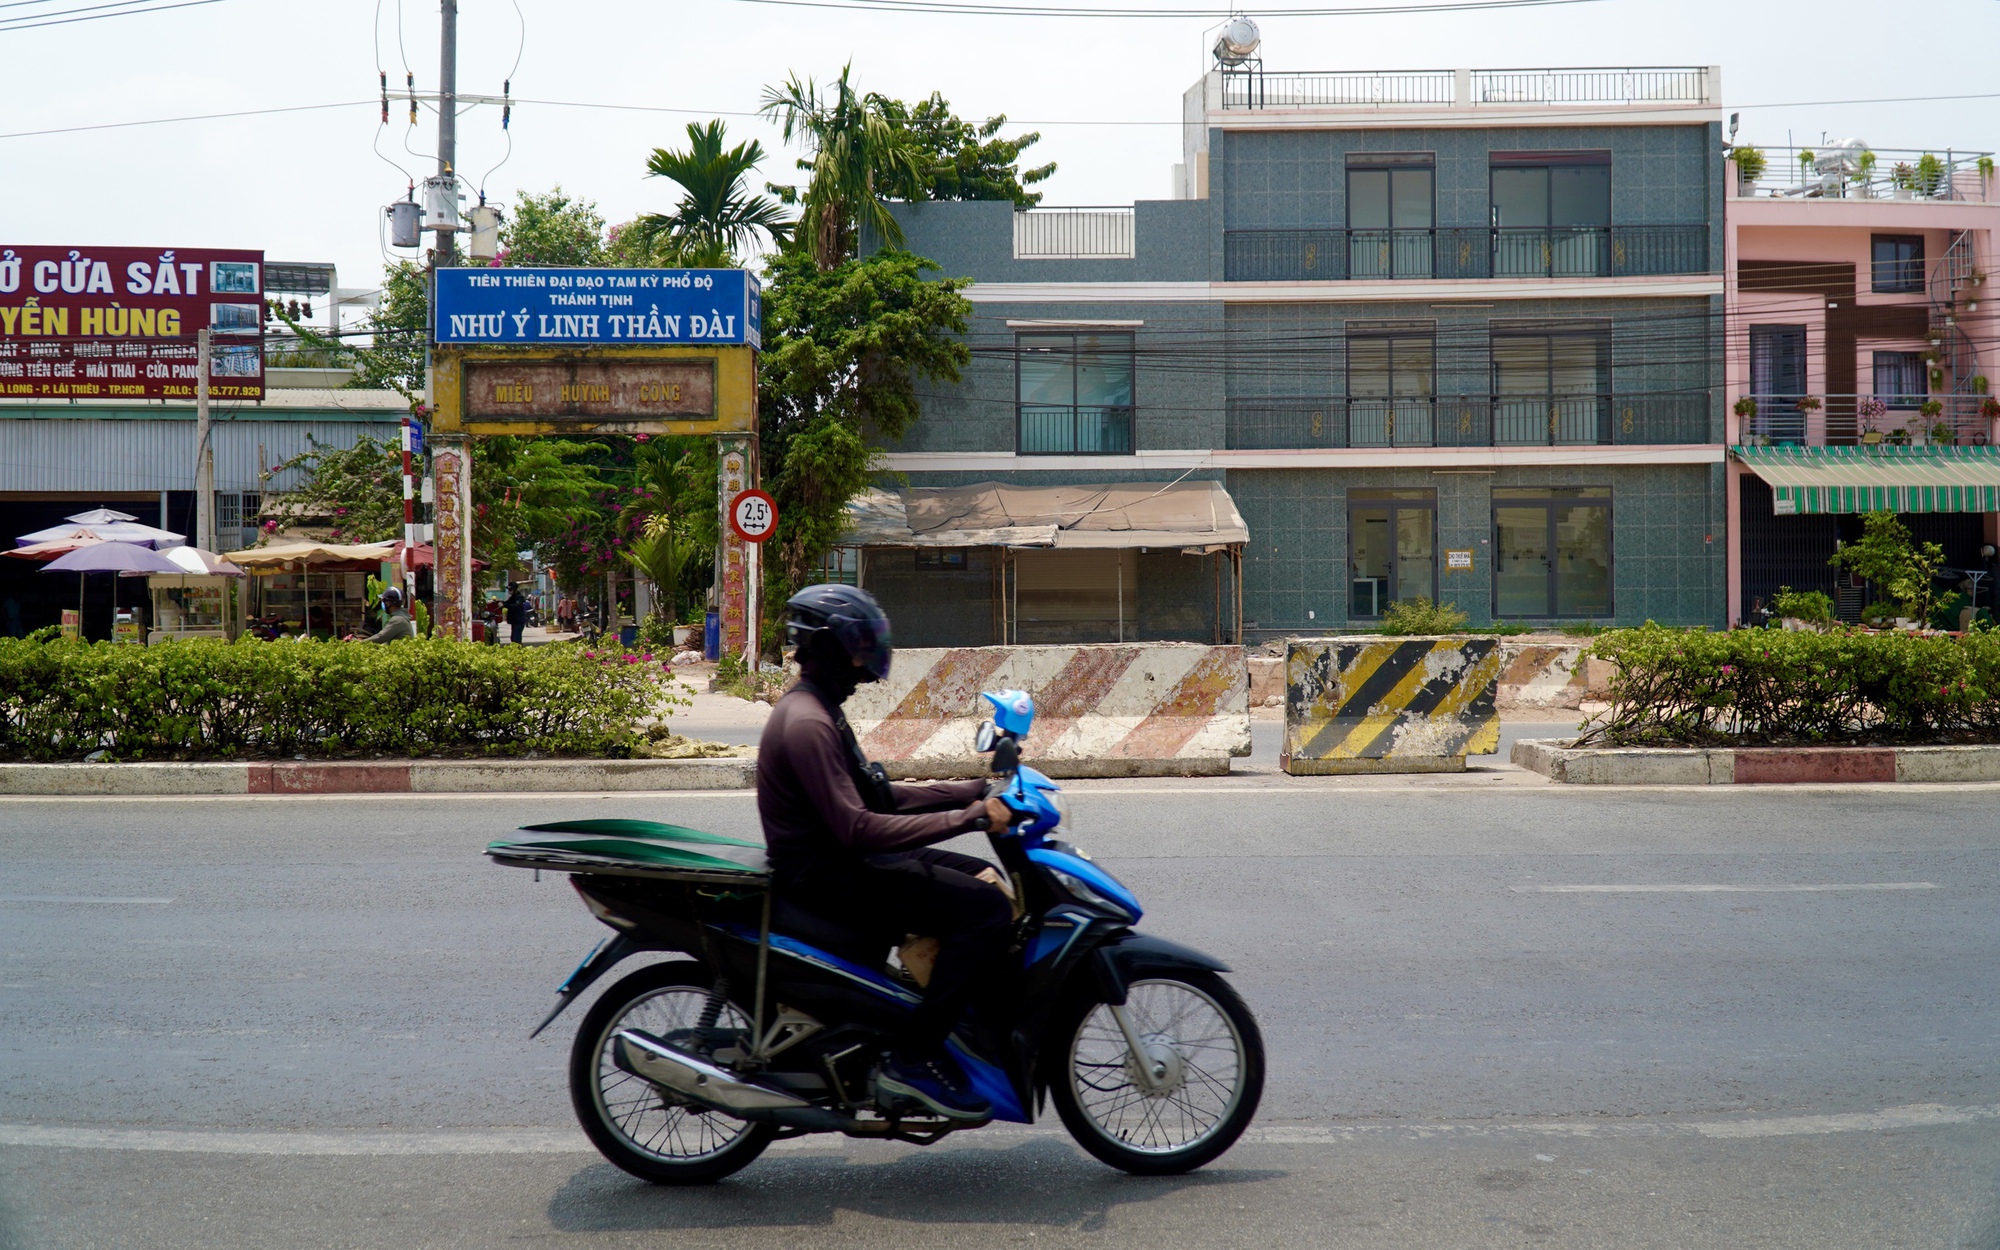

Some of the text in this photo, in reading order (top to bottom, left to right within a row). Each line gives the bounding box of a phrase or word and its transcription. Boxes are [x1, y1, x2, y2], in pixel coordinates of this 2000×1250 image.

[34, 250, 114, 293] CỬA
[127, 250, 203, 295] SẮT
[468, 271, 713, 291] TIÊN THIÊN ĐẠI ĐẠO TAM KỲ PHỔ ĐỘ
[549, 292, 633, 308] THÁNH TỊNH
[81, 301, 180, 337] HÙNG
[450, 310, 506, 338] NHƯ
[511, 307, 530, 337] Ý
[538, 314, 600, 338] LINH
[608, 303, 681, 338] THẦN
[689, 308, 735, 338] ĐÀI
[31, 342, 61, 357] INOX
[73, 341, 112, 357] NHÔM
[116, 341, 147, 358] KÍNH
[26, 358, 51, 377] TIỀN
[54, 359, 76, 377] CHẾ
[86, 361, 108, 377] MÁI
[111, 362, 136, 378] THÁI
[146, 360, 169, 378] CỬA
[7, 384, 33, 394] LONG
[42, 384, 50, 394] P.
[53, 383, 69, 394] LÁI
[71, 383, 99, 395] THIÊU
[109, 385, 145, 395] TP.HCM
[163, 386, 191, 395] ZALO:
[194, 386, 261, 396] 045.777.929
[496, 378, 680, 403] MIẾU HUỲNH CÔNG
